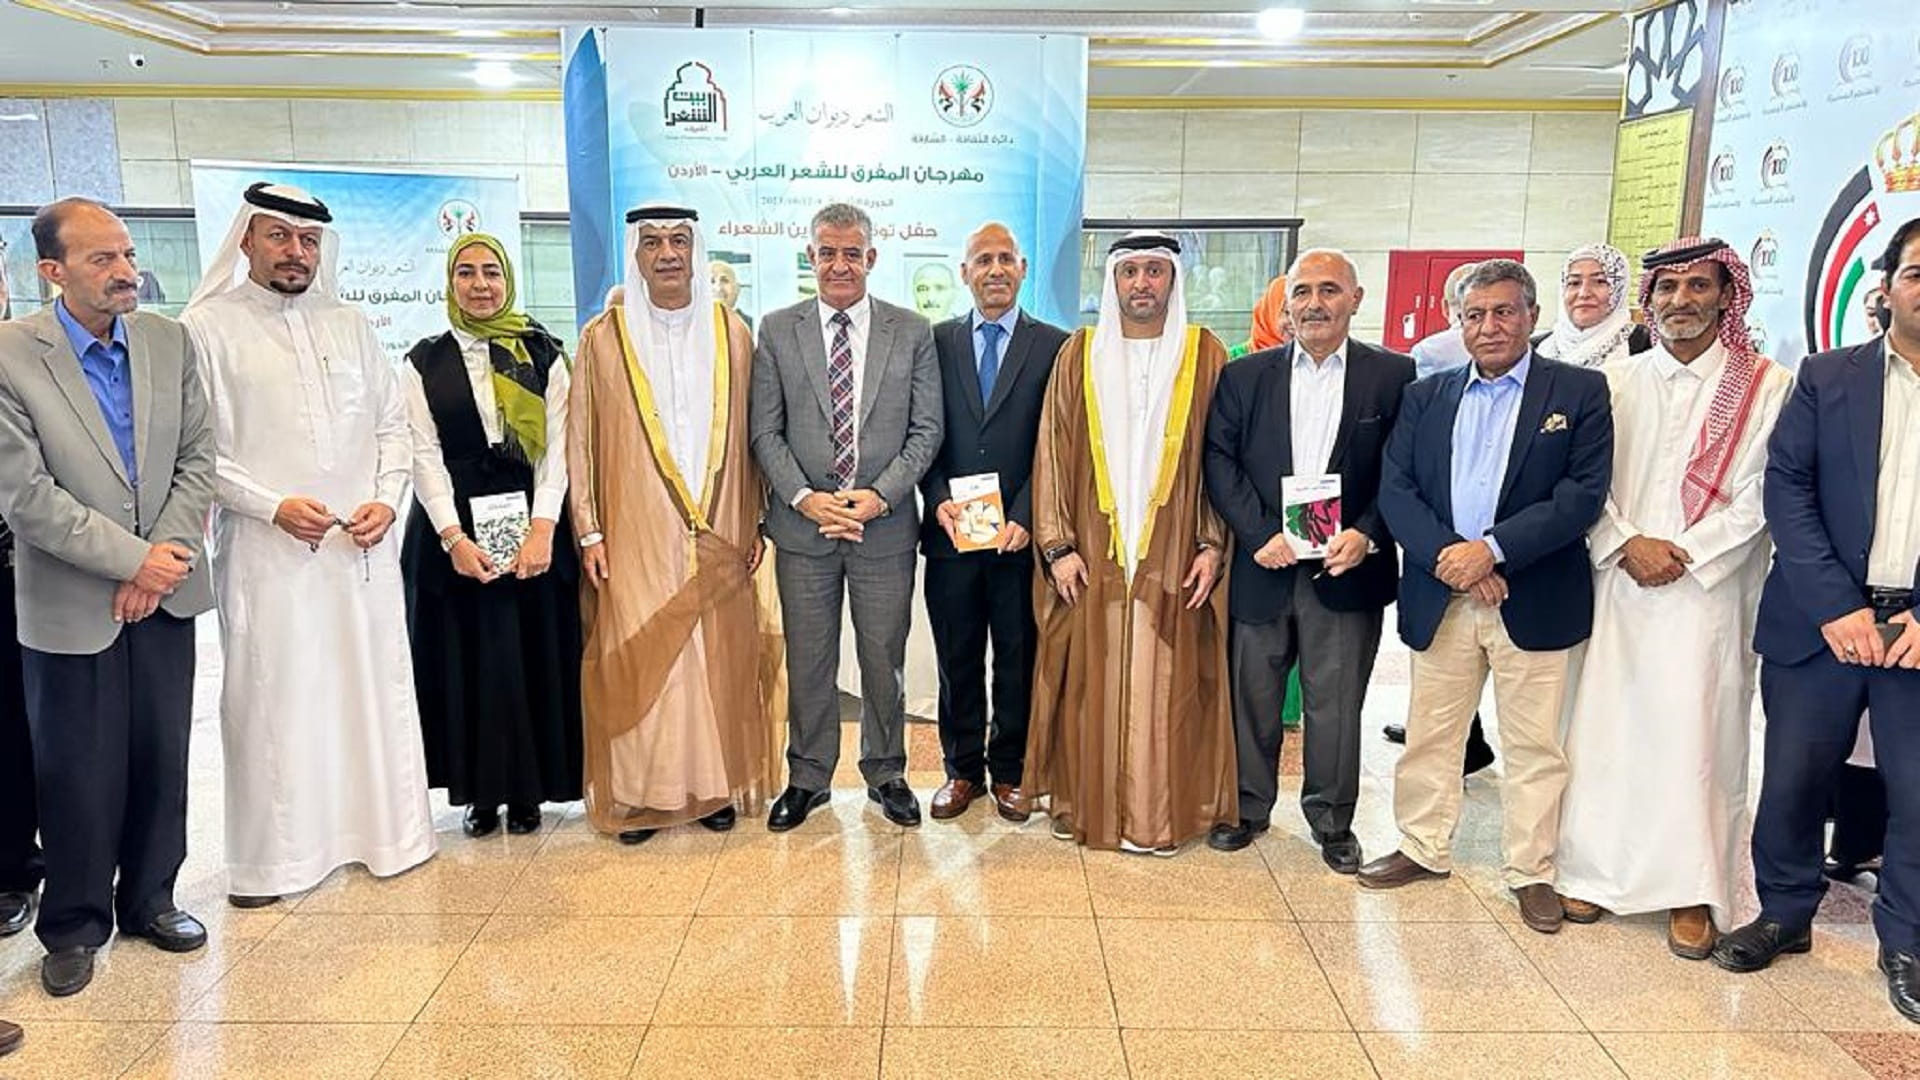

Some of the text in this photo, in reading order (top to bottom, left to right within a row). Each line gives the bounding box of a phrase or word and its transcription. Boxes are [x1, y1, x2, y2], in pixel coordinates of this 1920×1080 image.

[673, 91, 706, 106] بيت
[665, 92, 717, 127] الشعر
[758, 99, 894, 129] الشعر ديوان العرب
[725, 164, 785, 185] العربي
[790, 160, 848, 181] للشعر
[851, 163, 910, 183] المفرق
[914, 165, 984, 185] مهرجان
[1772, 157, 1788, 176] 100
[718, 218, 784, 237] الشعراء
[899, 222, 938, 240] حفل
[368, 286, 421, 305] المفرق
